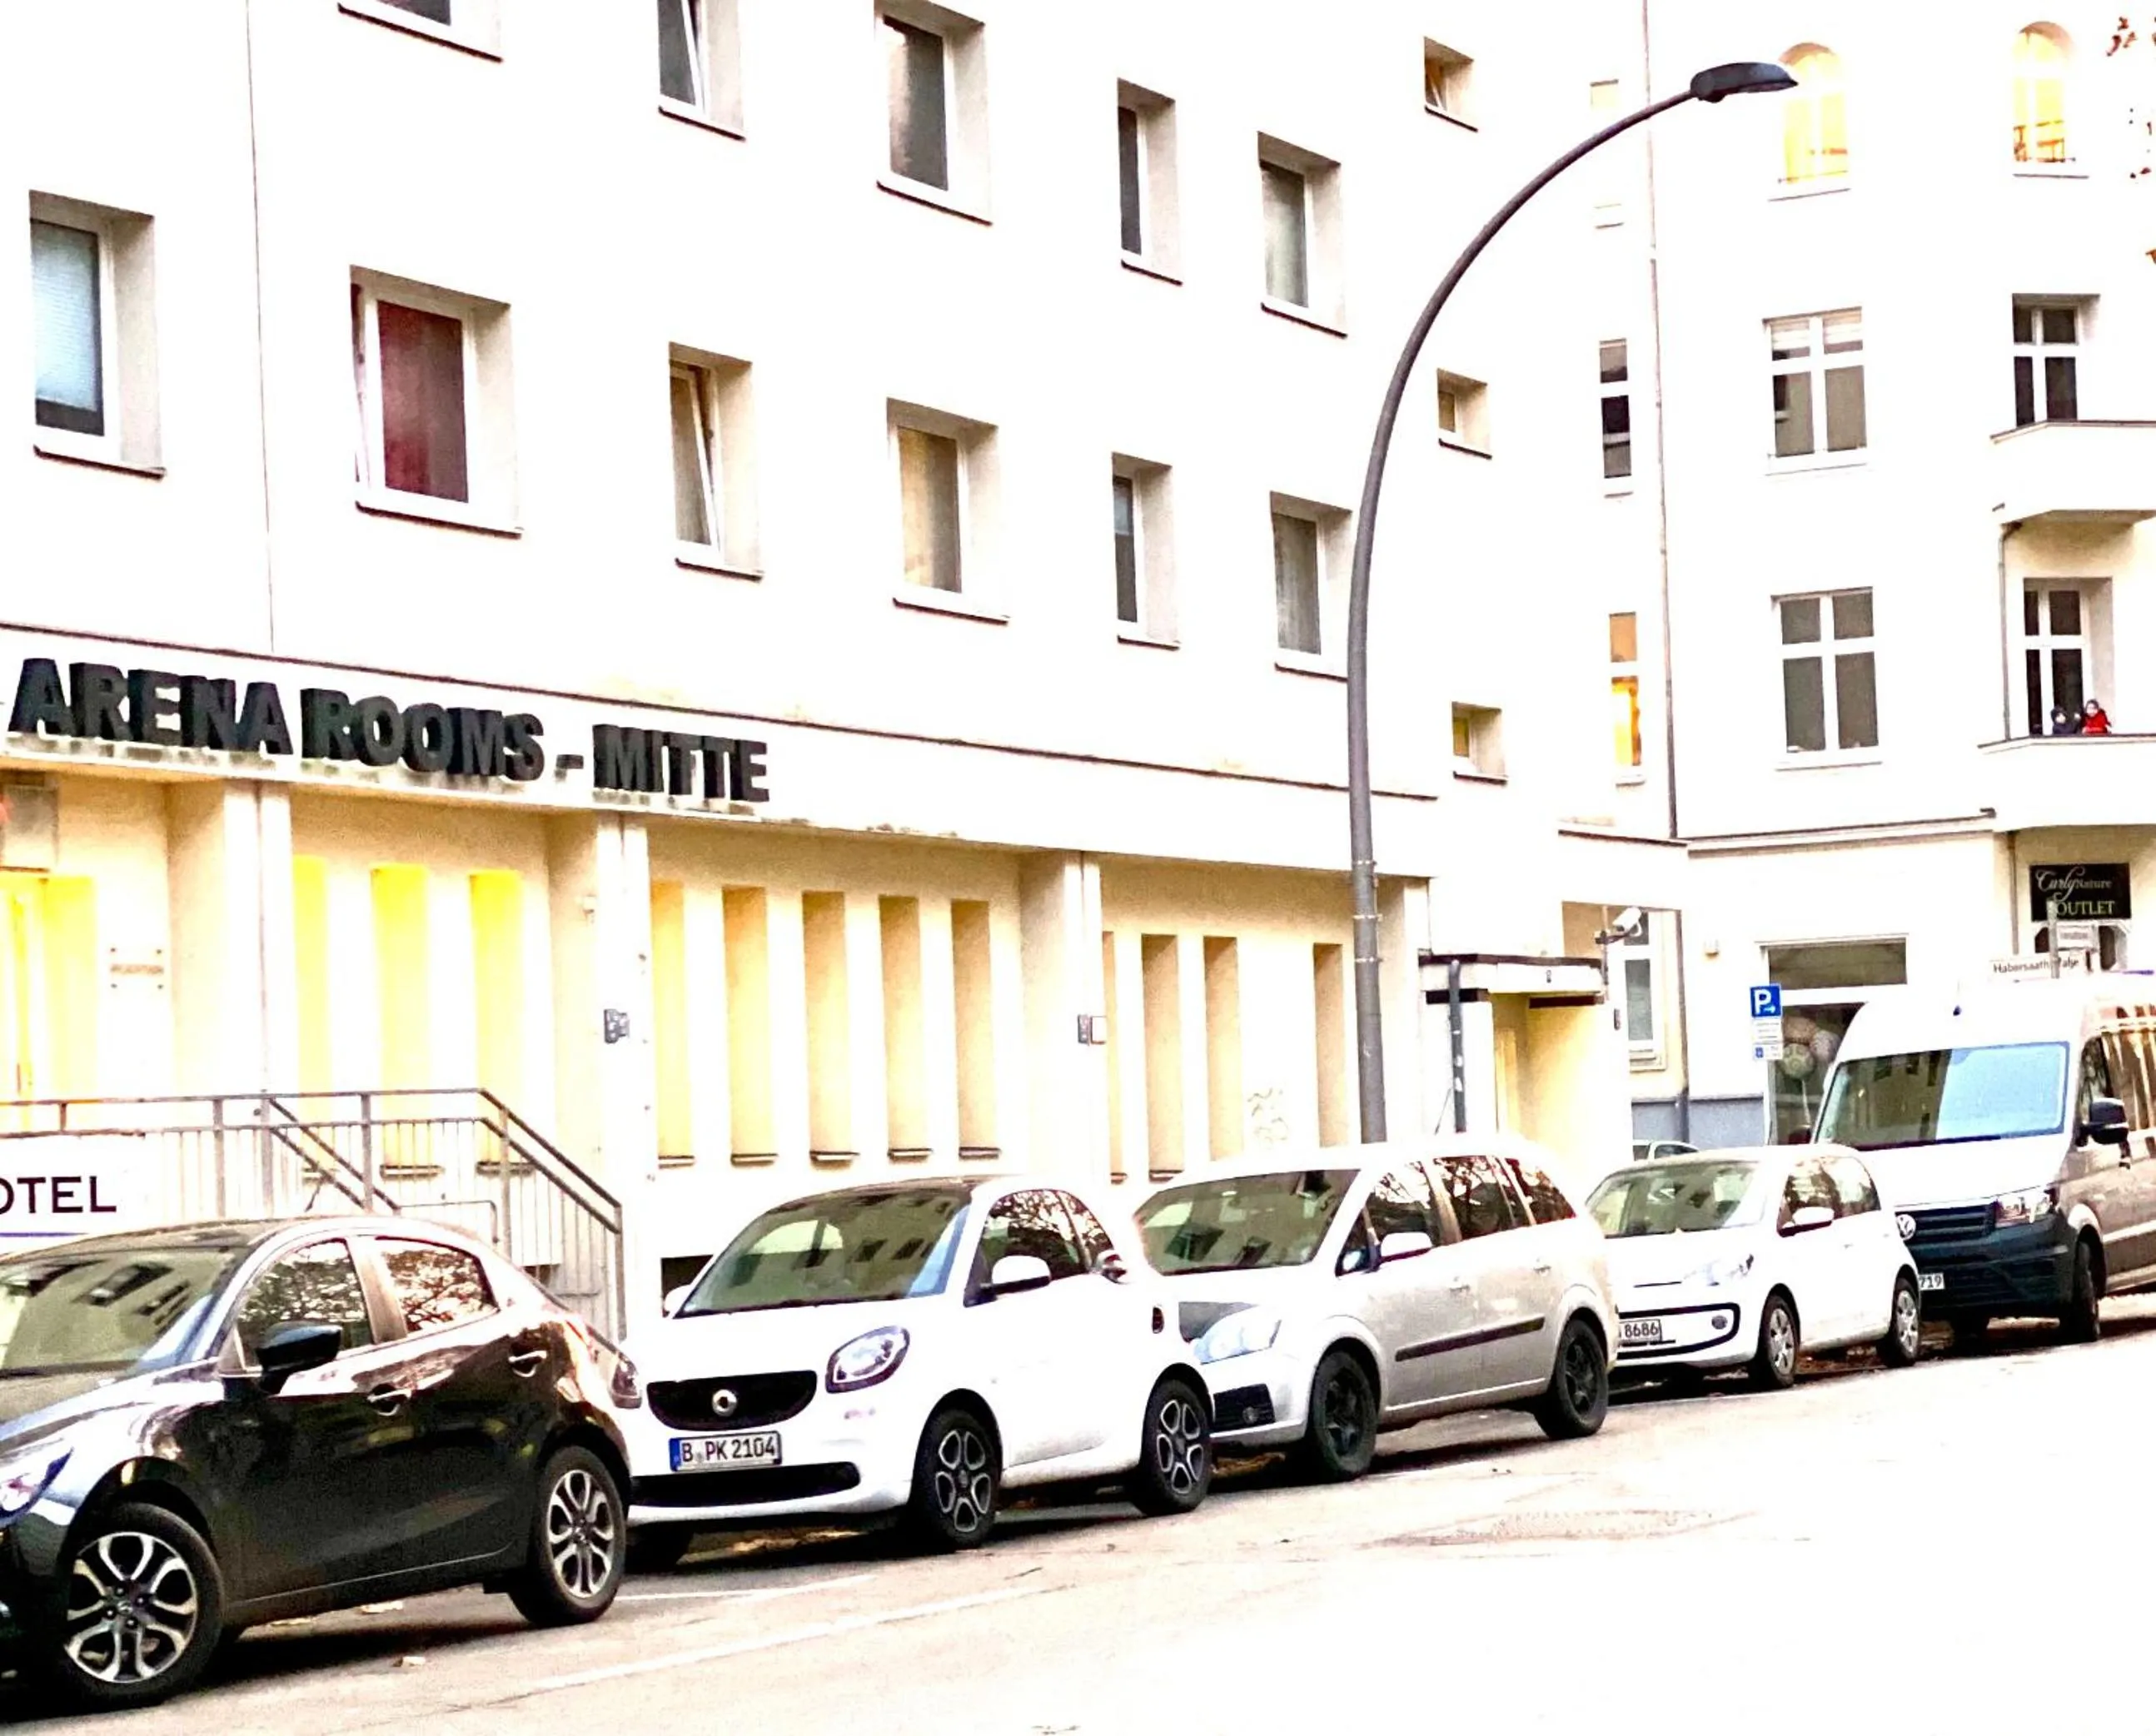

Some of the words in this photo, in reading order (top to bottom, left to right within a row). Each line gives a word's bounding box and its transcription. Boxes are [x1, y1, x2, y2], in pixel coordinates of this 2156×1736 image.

[8, 658, 293, 754] ARENA
[301, 689, 544, 780] ROOMS
[593, 724, 769, 802] MITTE
[2056, 901, 2114, 915] OUTLET
[1993, 957, 2079, 973] Habersaathaße
[1753, 988, 1772, 1015] P
[1624, 1321, 1659, 1338] 8686
[681, 1443, 693, 1462] B
[705, 1440, 728, 1460] PK
[731, 1436, 775, 1459] 2104
